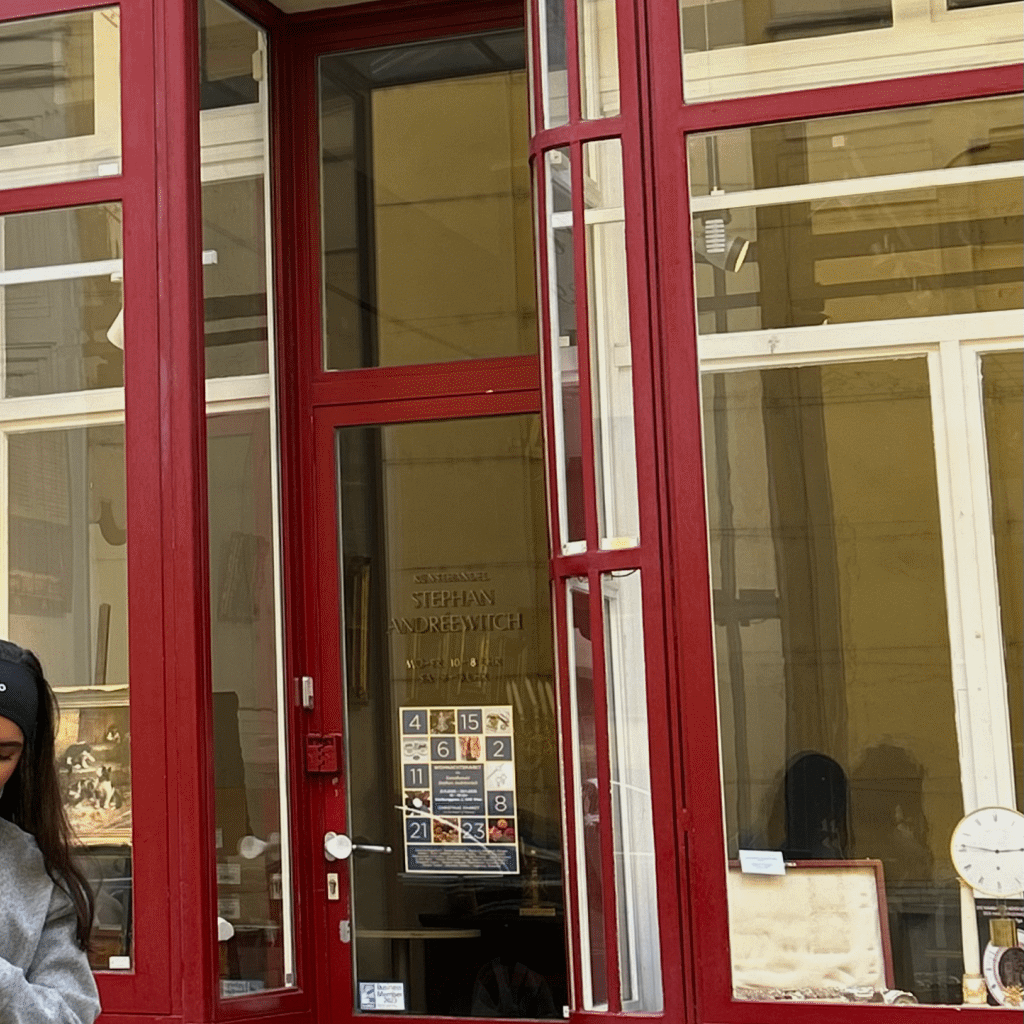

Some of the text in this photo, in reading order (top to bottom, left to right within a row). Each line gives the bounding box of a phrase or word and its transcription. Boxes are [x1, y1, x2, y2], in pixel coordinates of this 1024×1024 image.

[412, 589, 495, 608] STEPHAN
[409, 713, 479, 731] 4 15
[437, 740, 504, 757] 6 2
[410, 768, 423, 784] 11
[494, 795, 507, 812] 8
[410, 822, 485, 839] 21 23
